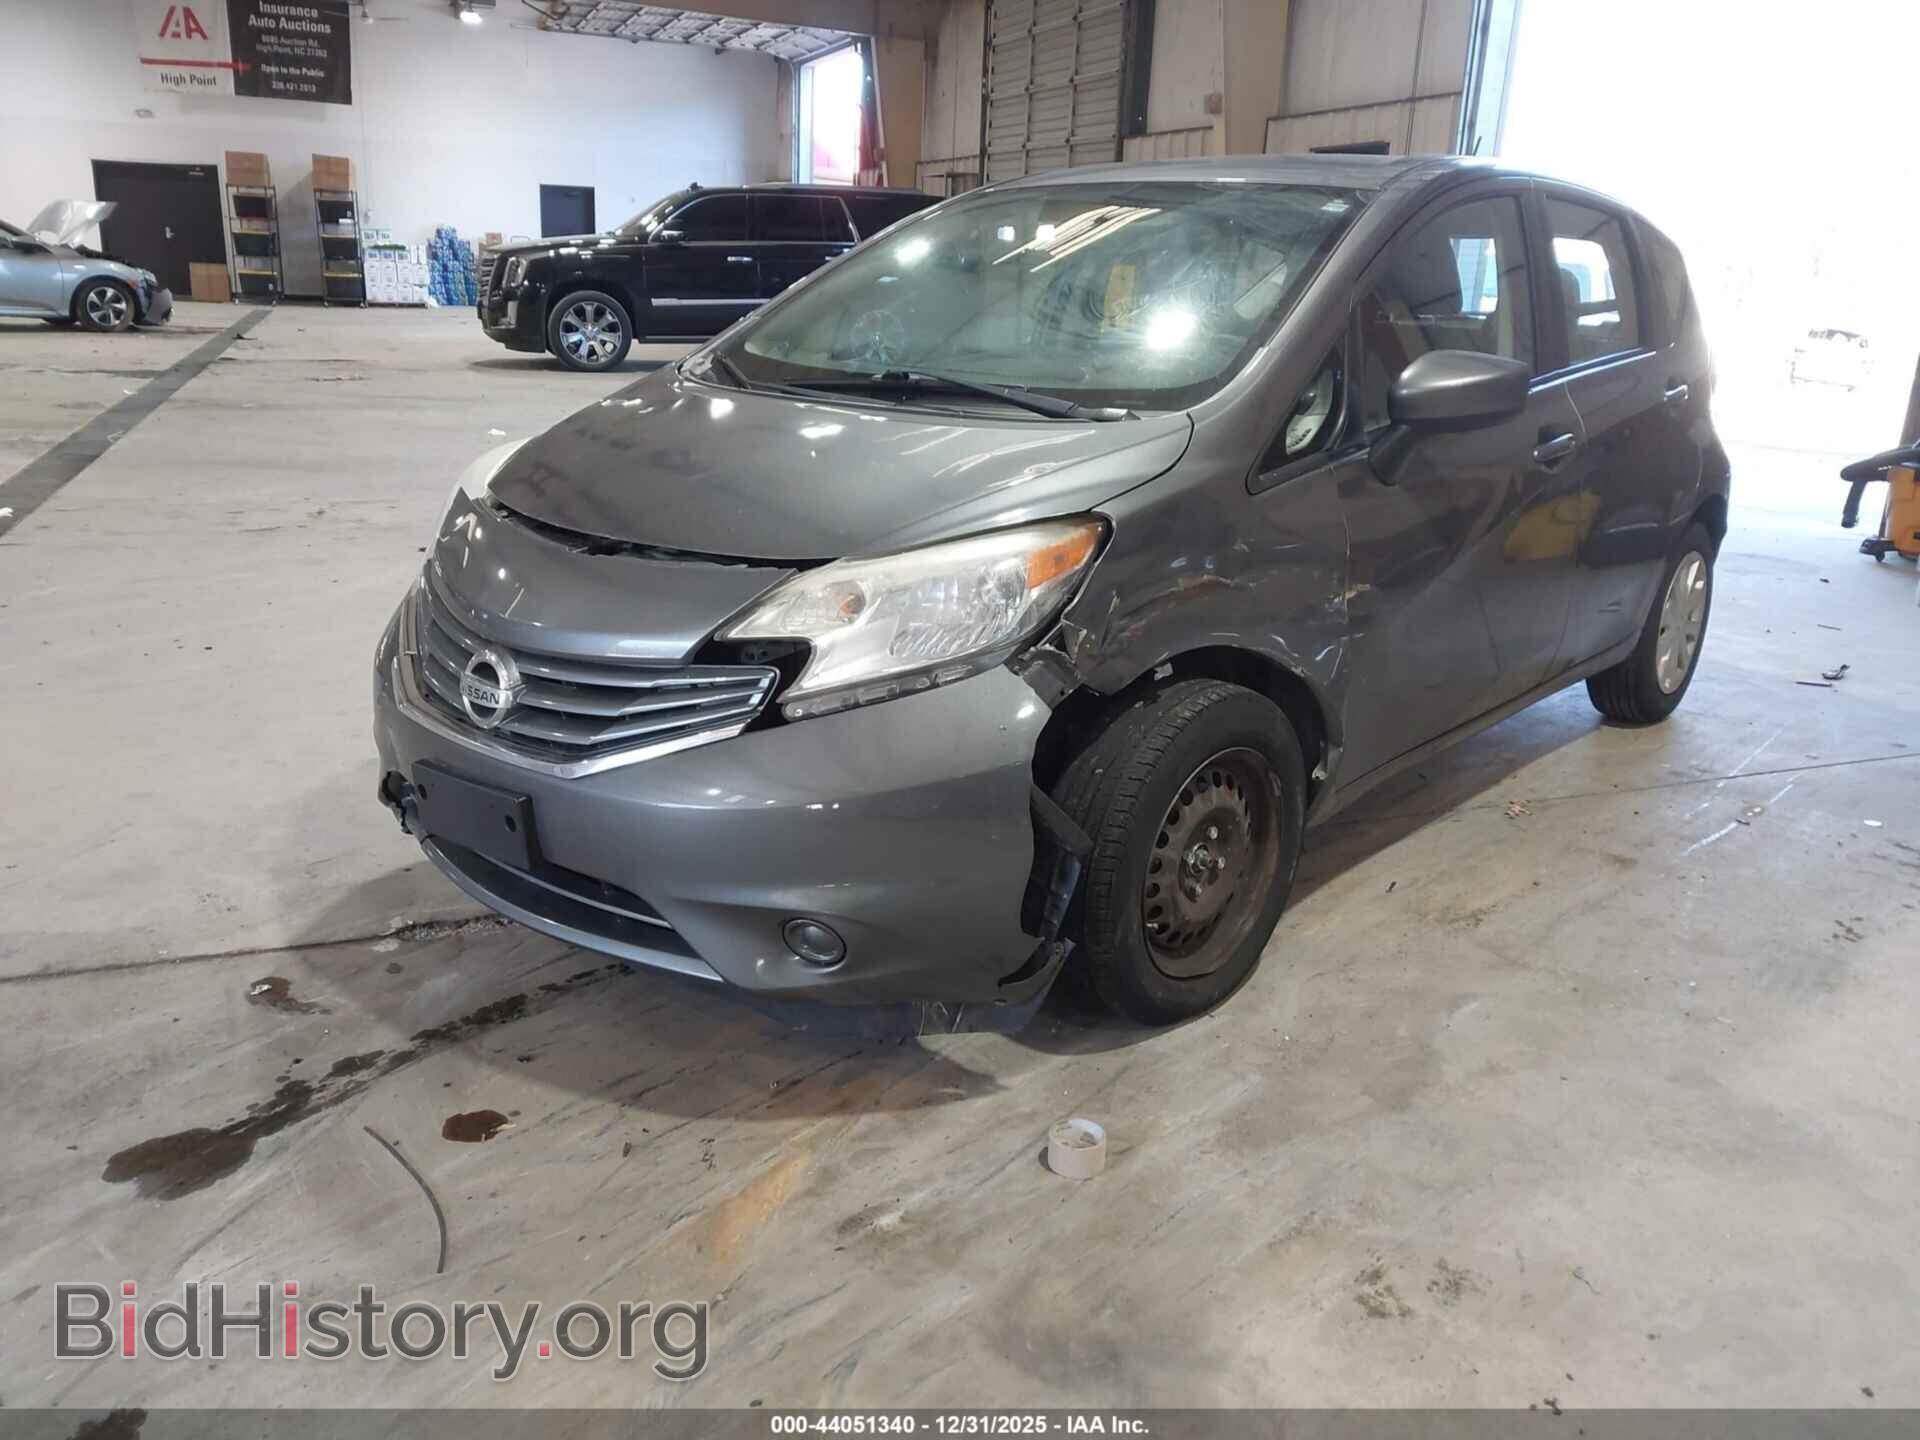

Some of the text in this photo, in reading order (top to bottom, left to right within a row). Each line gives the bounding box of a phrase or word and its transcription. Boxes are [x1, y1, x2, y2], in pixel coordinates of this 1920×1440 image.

[259, 0, 319, 18] Insurance
[248, 14, 332, 34] Auto Auctions
[160, 72, 217, 86] High Point
[260, 64, 280, 73] Open
[302, 68, 324, 78] Public
